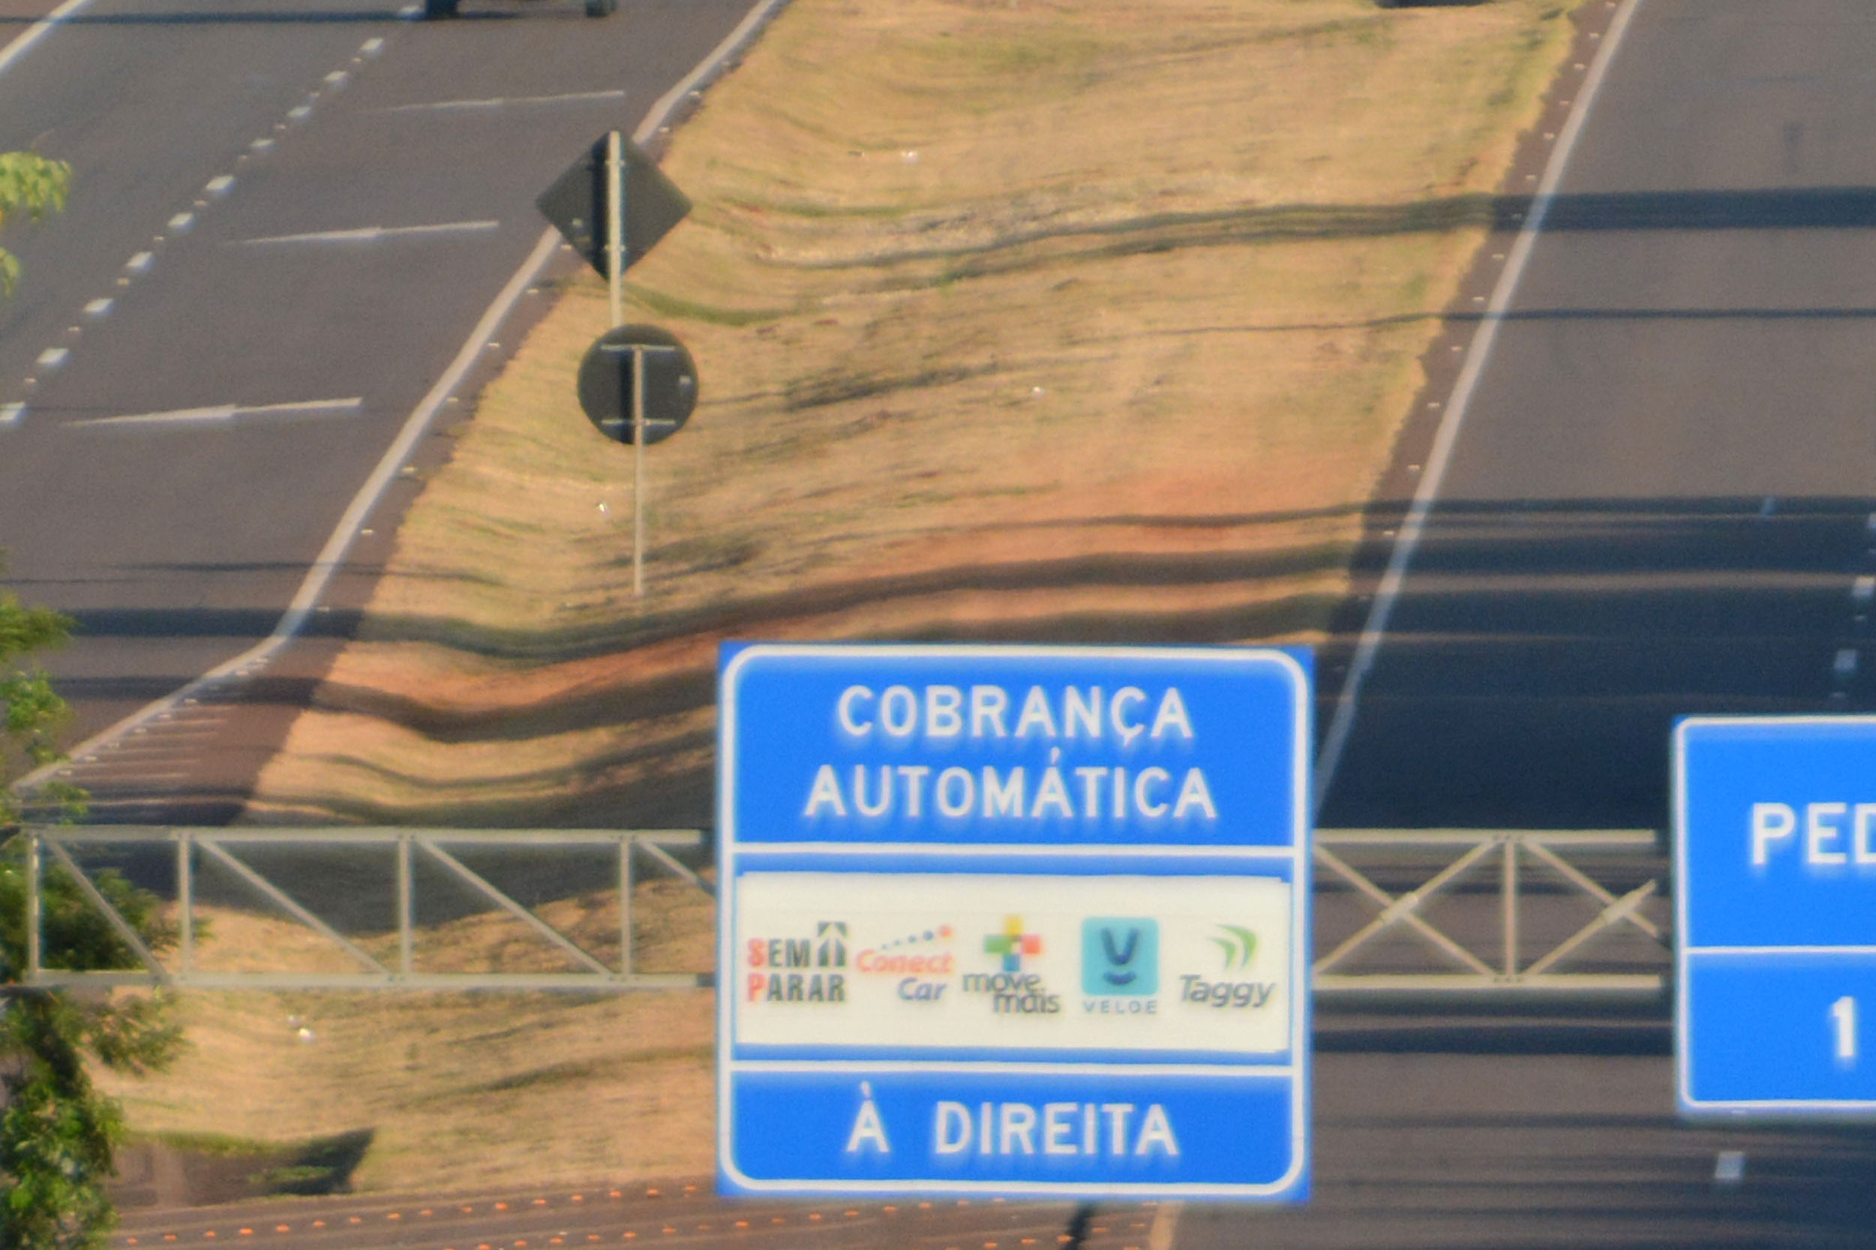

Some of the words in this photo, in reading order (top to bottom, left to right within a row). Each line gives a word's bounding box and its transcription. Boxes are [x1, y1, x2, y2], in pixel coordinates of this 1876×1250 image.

[838, 684, 1196, 747] COBRANÇA
[803, 746, 1218, 819] AUTOMÁTICA
[748, 937, 812, 968] SEM
[748, 972, 847, 1001] PARAR
[898, 976, 948, 1001] Car
[962, 972, 1042, 993] move
[1179, 974, 1277, 1008] Taggy
[991, 986, 1061, 1014] mais
[1083, 999, 1158, 1015] VELOE
[1832, 995, 1856, 1058] 1
[846, 1080, 890, 1153] À
[935, 1100, 1179, 1156] DIREITA
